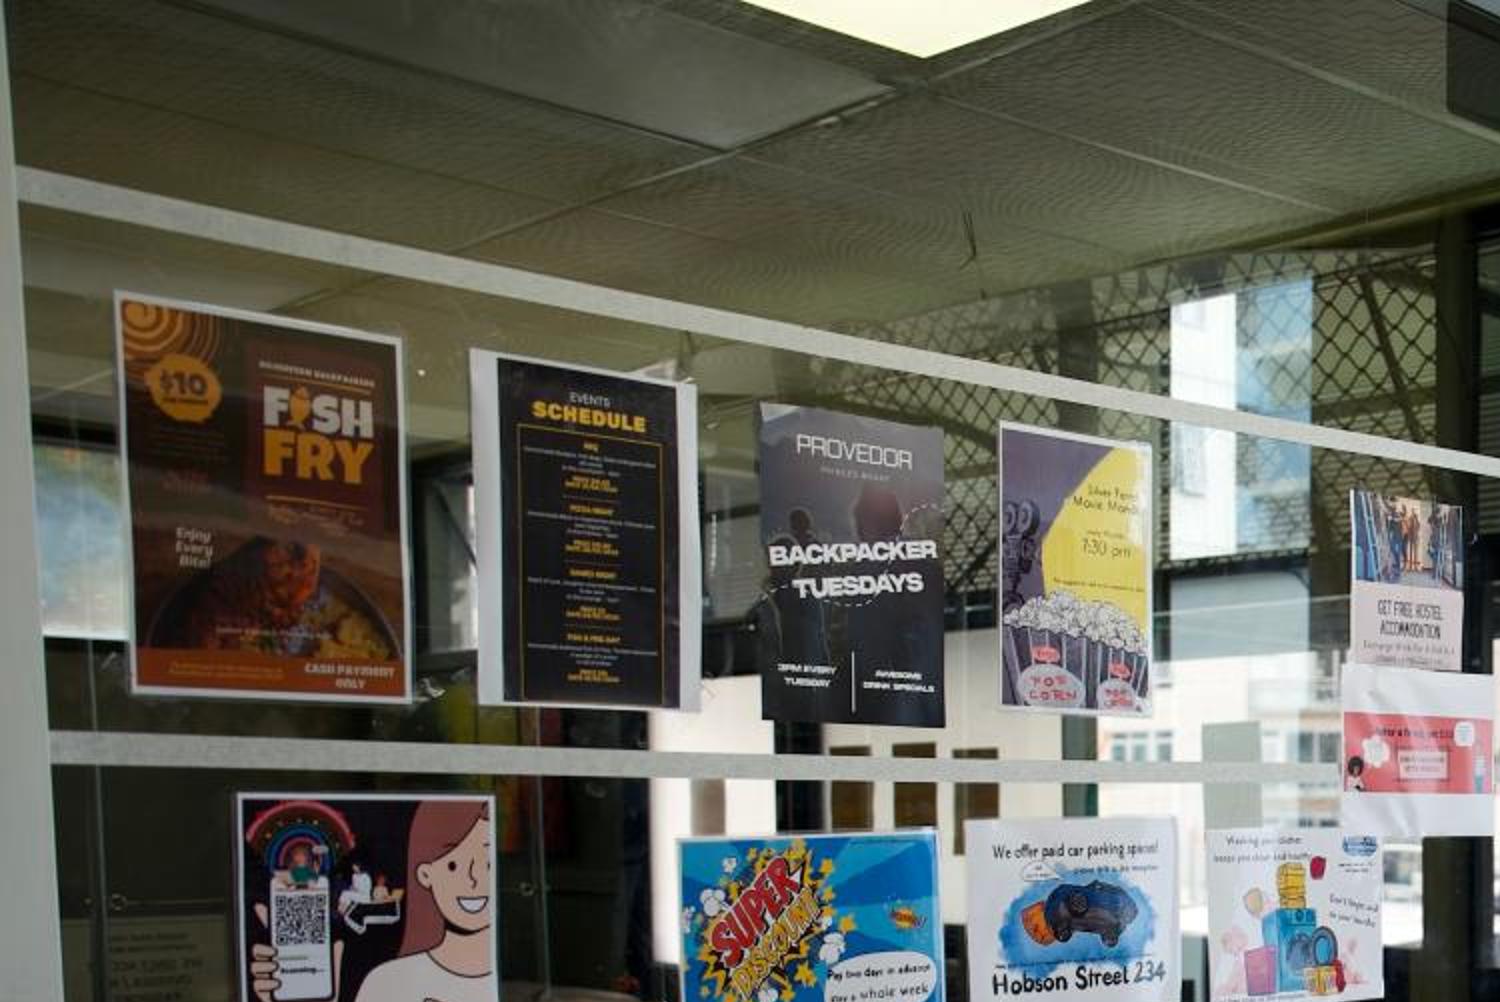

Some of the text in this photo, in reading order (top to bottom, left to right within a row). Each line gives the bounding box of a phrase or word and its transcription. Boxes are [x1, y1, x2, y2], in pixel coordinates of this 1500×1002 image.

[159, 368, 208, 397] $10
[569, 391, 611, 408] EVENTS
[531, 401, 646, 433] SCHEDULE
[264, 428, 374, 484] FRY
[796, 434, 913, 470] PROVEDOR
[768, 539, 938, 567] BACKPACKER
[791, 572, 925, 599] TUESDAYS
[992, 845, 1012, 859] We
[1014, 844, 1037, 858] offer
[1042, 844, 1065, 858] paid
[1067, 846, 1084, 857] car
[1087, 843, 1124, 859] parking
[711, 856, 801, 968] SUPER
[992, 961, 1166, 996] Hobson Street 234
